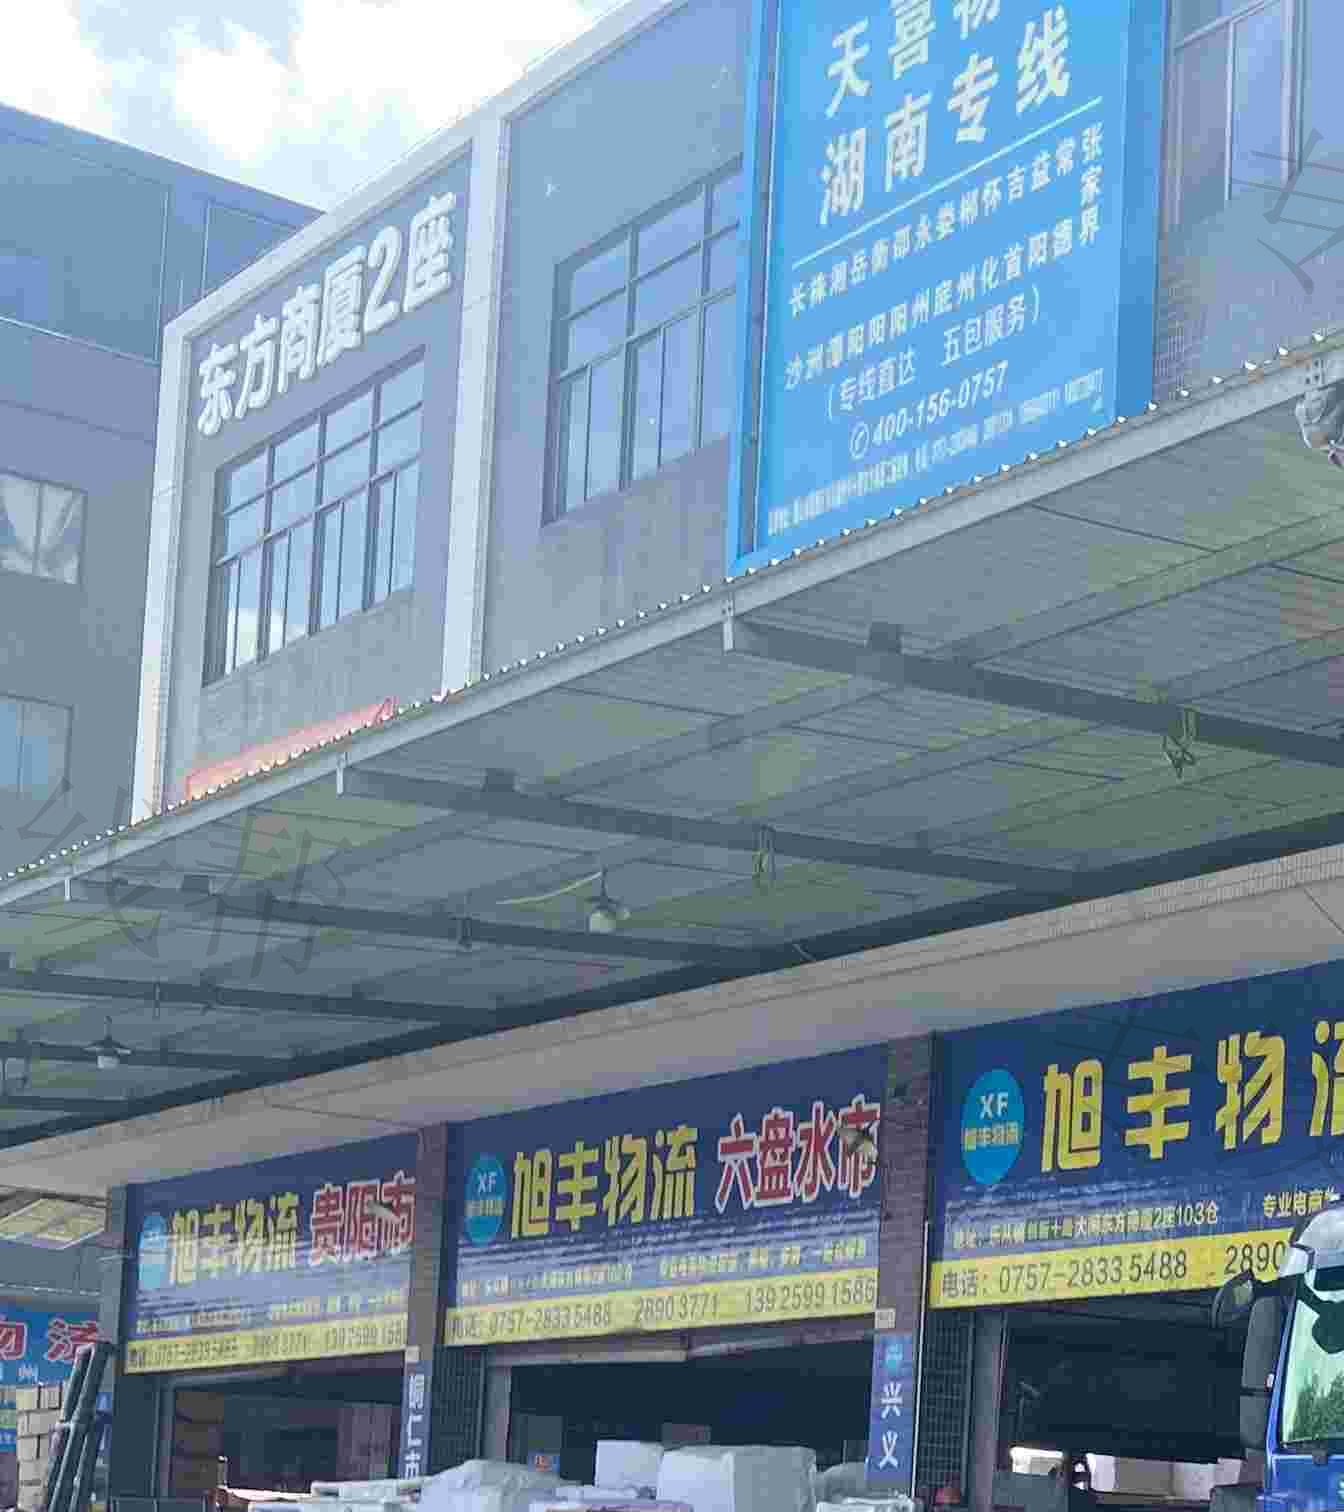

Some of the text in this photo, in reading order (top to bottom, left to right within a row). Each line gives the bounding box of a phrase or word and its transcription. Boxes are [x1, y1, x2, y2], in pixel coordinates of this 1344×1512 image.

[820, 4, 1071, 227] 湖南专线
[196, 190, 458, 438] 东方商厦2座
[871, 360, 1010, 446] 400-156-0757
[512, 1093, 882, 1240] 旭丰物流 六盘水市
[979, 1091, 1010, 1120] XF
[169, 1170, 416, 1287] 旭丰物流 贵阳市
